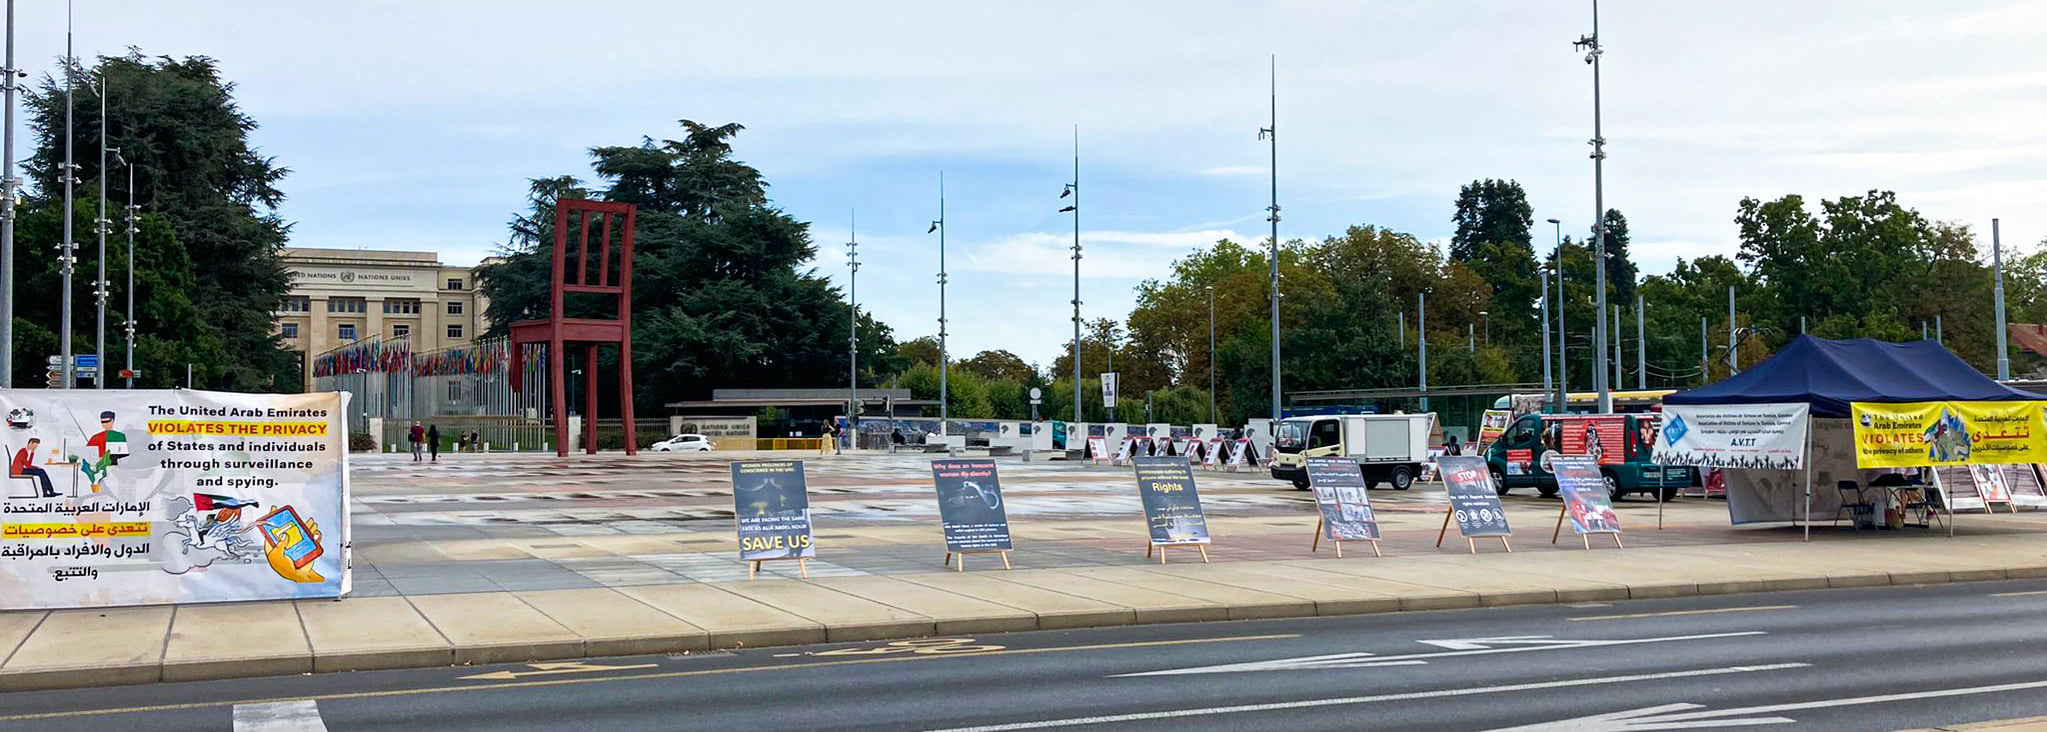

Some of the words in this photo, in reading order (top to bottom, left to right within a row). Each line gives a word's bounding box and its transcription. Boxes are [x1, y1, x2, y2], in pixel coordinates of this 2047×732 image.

[149, 406, 176, 416] The
[179, 406, 226, 417] United
[230, 407, 263, 417] Arab
[267, 407, 328, 417] Emirates
[148, 422, 225, 434] VIOLATES
[229, 424, 258, 434] THE
[263, 424, 328, 434] PRIVACY
[1862, 433, 1924, 444] VIOLATES
[148, 441, 163, 451] of
[167, 441, 215, 451] States
[218, 441, 245, 451] and
[249, 442, 326, 452] individuals
[160, 458, 220, 471] through
[224, 459, 313, 469] surveillance
[196, 476, 223, 487] and
[227, 477, 279, 488] spying.
[1457, 470, 1478, 482] STOP
[1152, 482, 1184, 494] Rights
[3, 502, 52, 514] المتحدة
[55, 502, 99, 516] العربية
[102, 501, 150, 517] الإمارات
[4, 524, 78, 538] خصوصيات
[80, 525, 105, 537] على
[107, 522, 148, 536] تتعدى
[743, 536, 784, 551] SAVE
[788, 534, 809, 549] US
[1, 544, 60, 561] بالمراقبة
[114, 543, 150, 558] الدول
